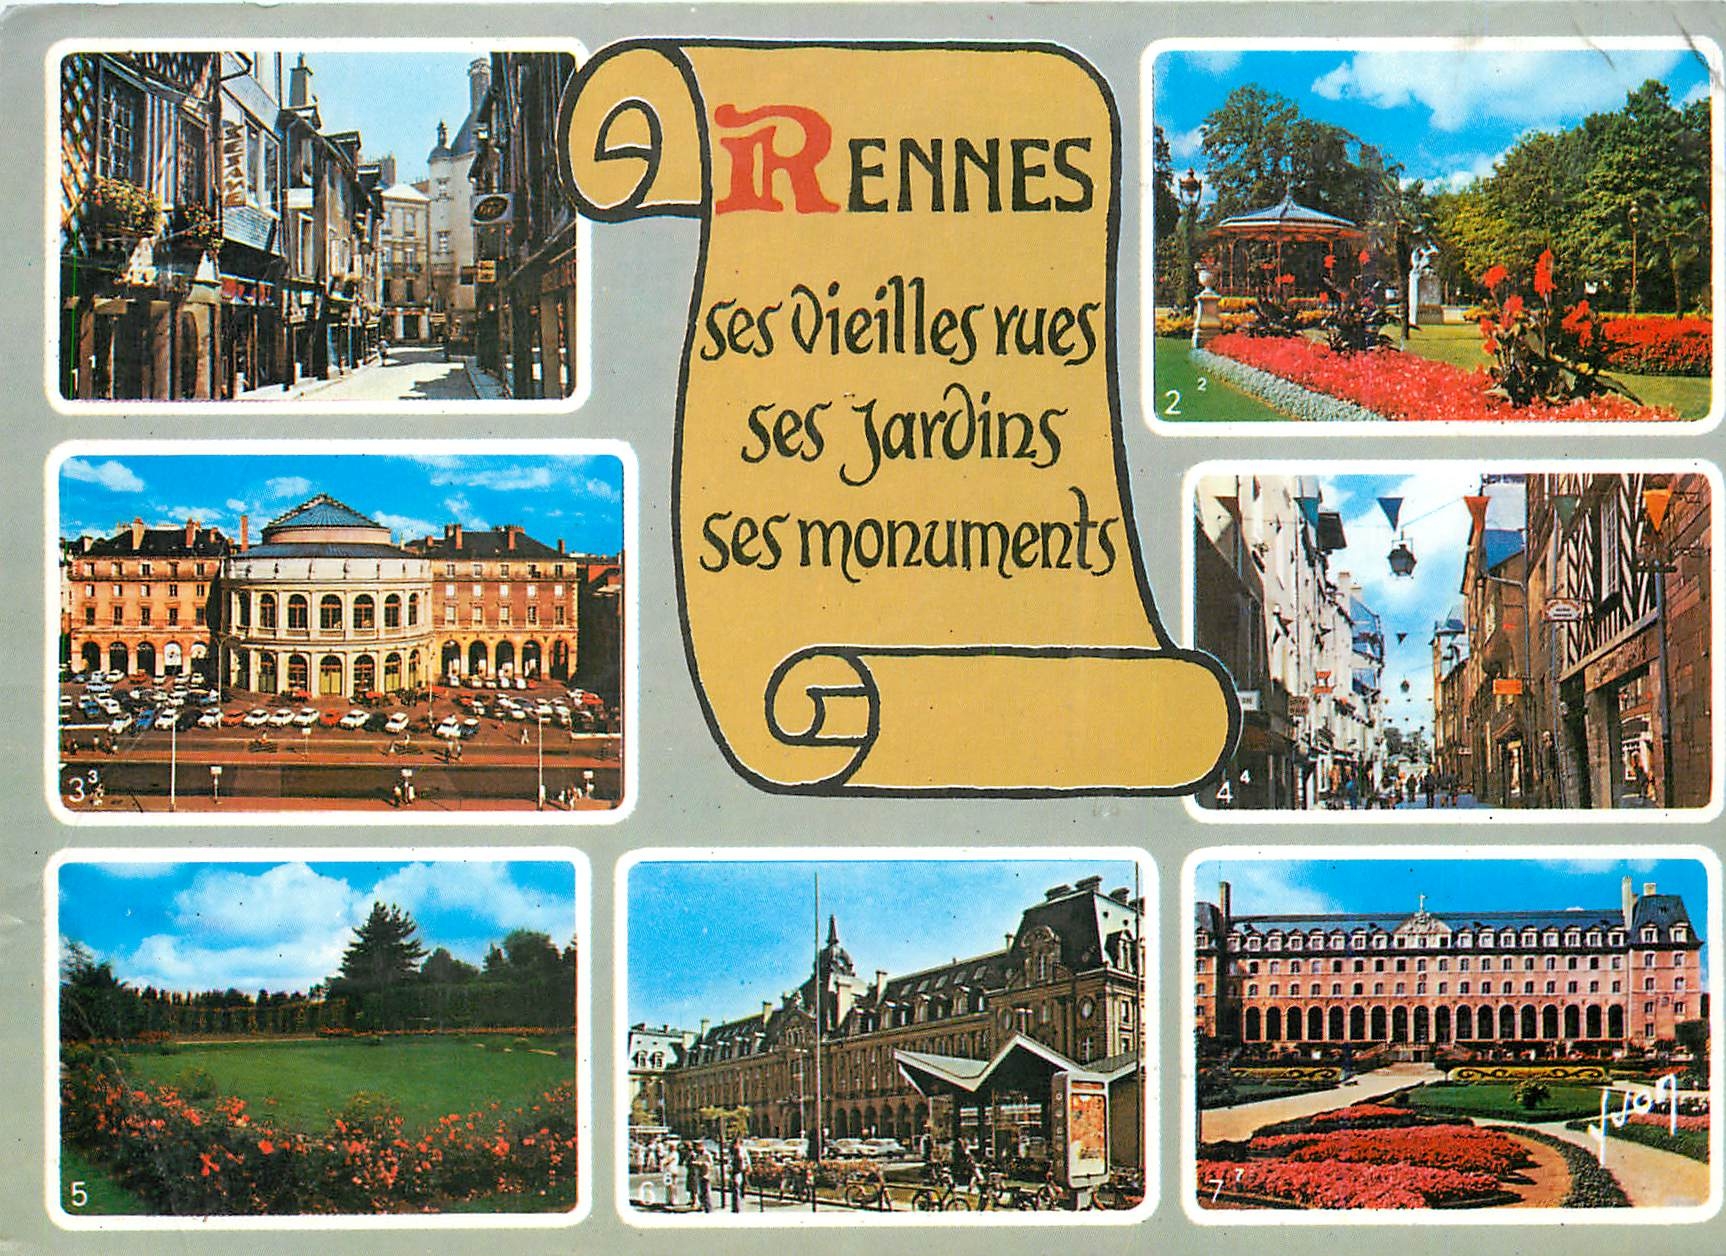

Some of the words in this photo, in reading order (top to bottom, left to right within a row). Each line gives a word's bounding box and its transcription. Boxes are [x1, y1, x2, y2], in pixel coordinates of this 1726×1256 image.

[713, 104, 1094, 216] RENNES
[699, 297, 783, 362] ses
[993, 301, 1102, 367] rues
[1197, 377, 1207, 391] 2
[1164, 389, 1181, 415] 2
[740, 400, 832, 464] ses
[698, 509, 791, 573] ses
[797, 485, 1119, 584] monuments
[88, 769, 98, 784] 3
[1240, 769, 1251, 784] 4
[69, 777, 84, 803] 3
[1216, 780, 1234, 804] 4
[71, 1181, 88, 1207] 5
[1209, 1179, 1224, 1203] 7
